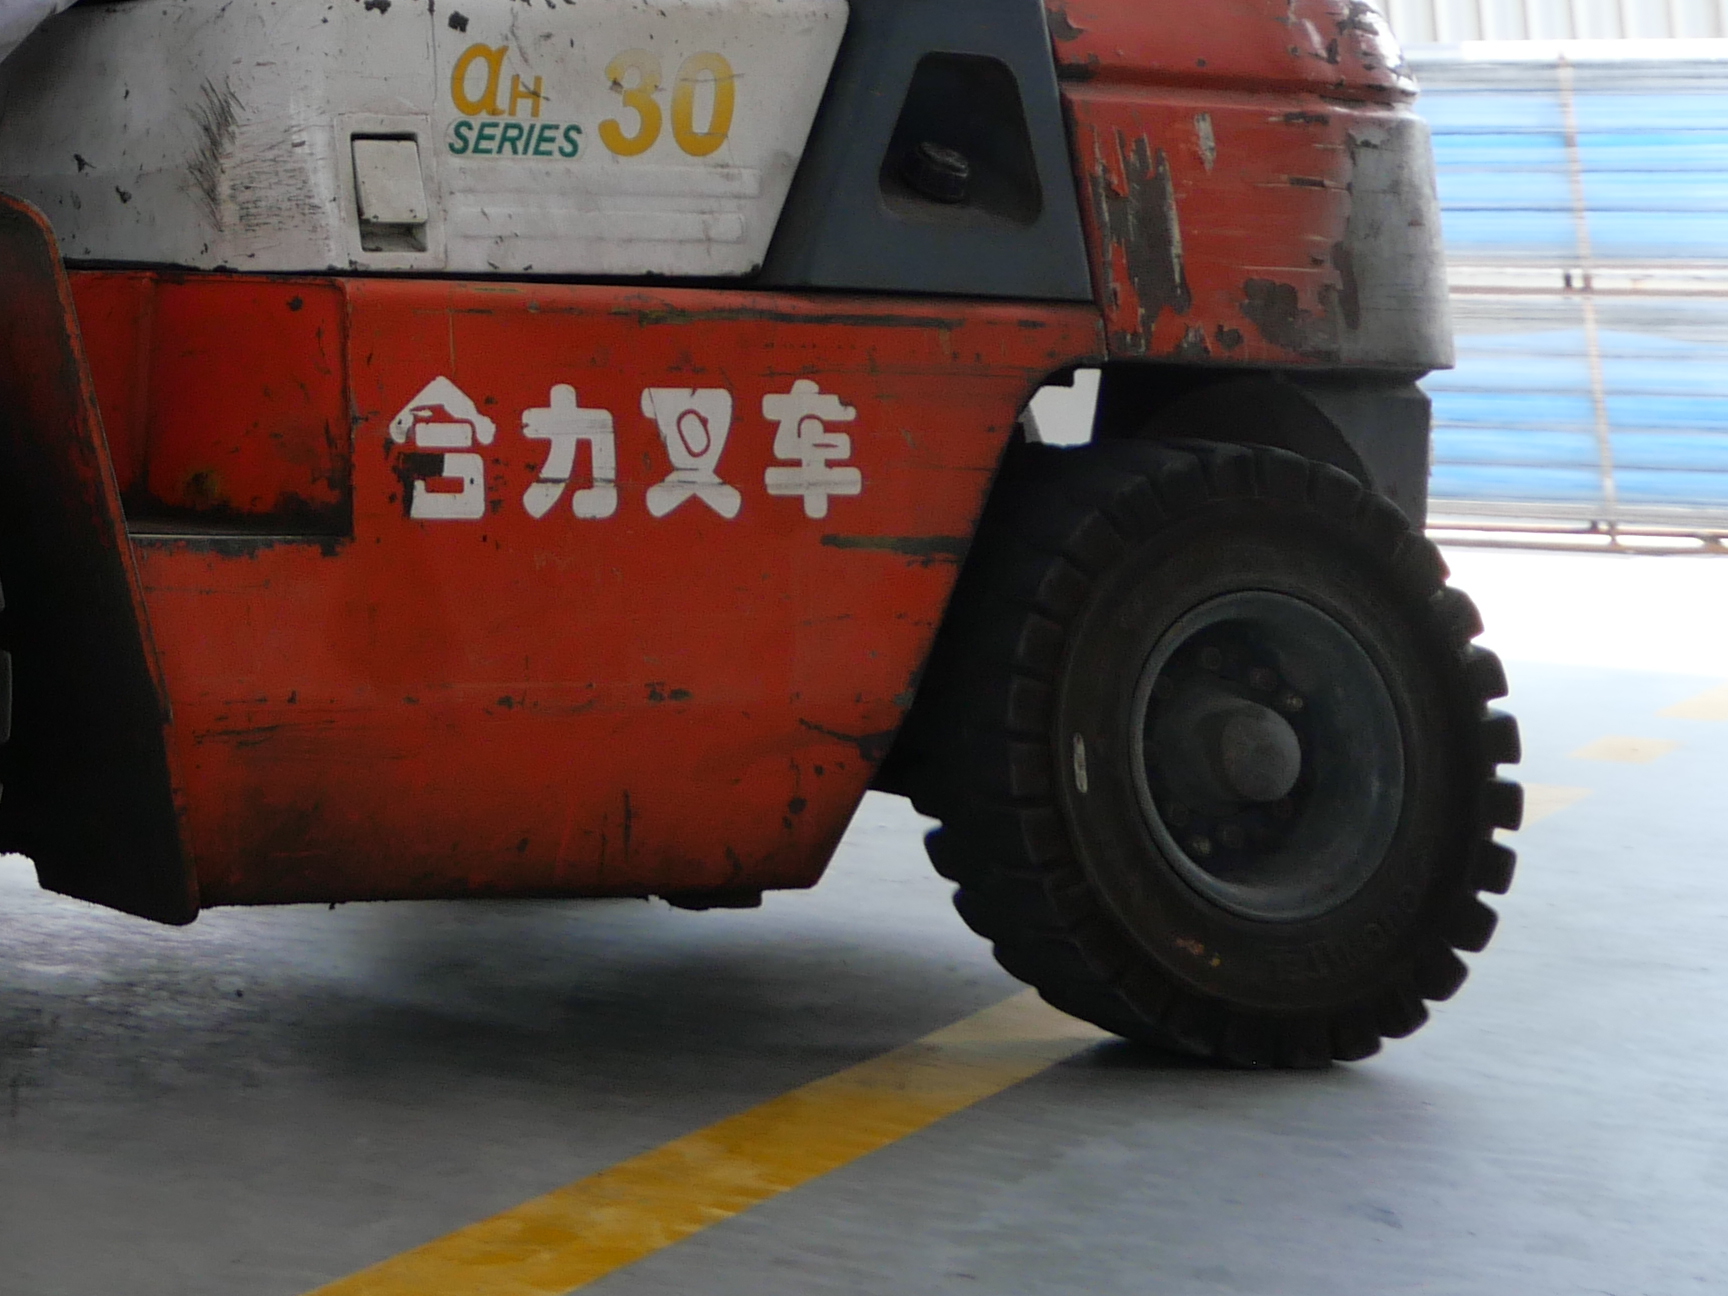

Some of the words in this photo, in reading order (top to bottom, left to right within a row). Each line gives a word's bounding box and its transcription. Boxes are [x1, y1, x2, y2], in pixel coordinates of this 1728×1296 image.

[448, 120, 583, 158] SERIES
[598, 50, 737, 157] 30
[389, 375, 863, 520] 合力叉车
